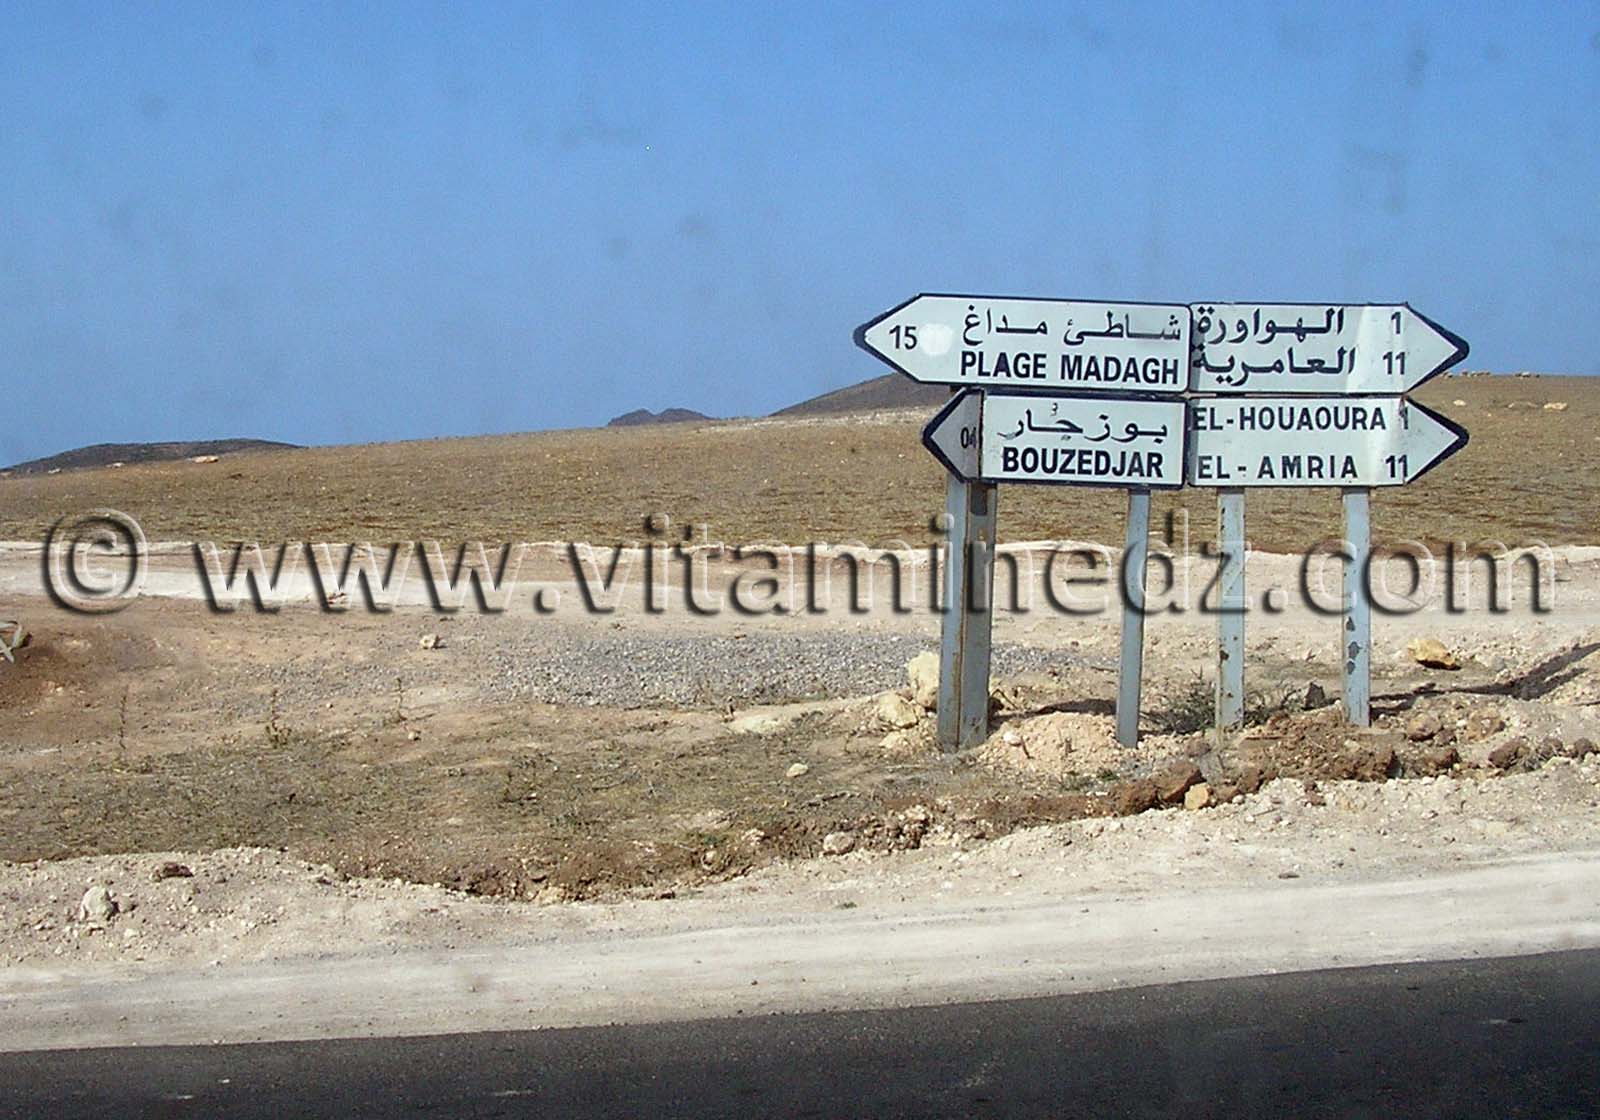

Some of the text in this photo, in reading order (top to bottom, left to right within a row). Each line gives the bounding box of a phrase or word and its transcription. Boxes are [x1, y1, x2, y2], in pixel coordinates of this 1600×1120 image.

[889, 325, 917, 349] 15
[962, 304, 1048, 345] مداغ
[1197, 306, 1345, 345] الهواورة
[1391, 312, 1401, 334] 1
[960, 350, 1179, 385] PLAGE MADAGH
[1191, 343, 1356, 386] العامرية
[1383, 351, 1406, 375] 11
[1192, 406, 1387, 432] EL-HOUAOURA
[1002, 446, 1164, 478] BOUZEDJAR
[1385, 455, 1408, 478] 11
